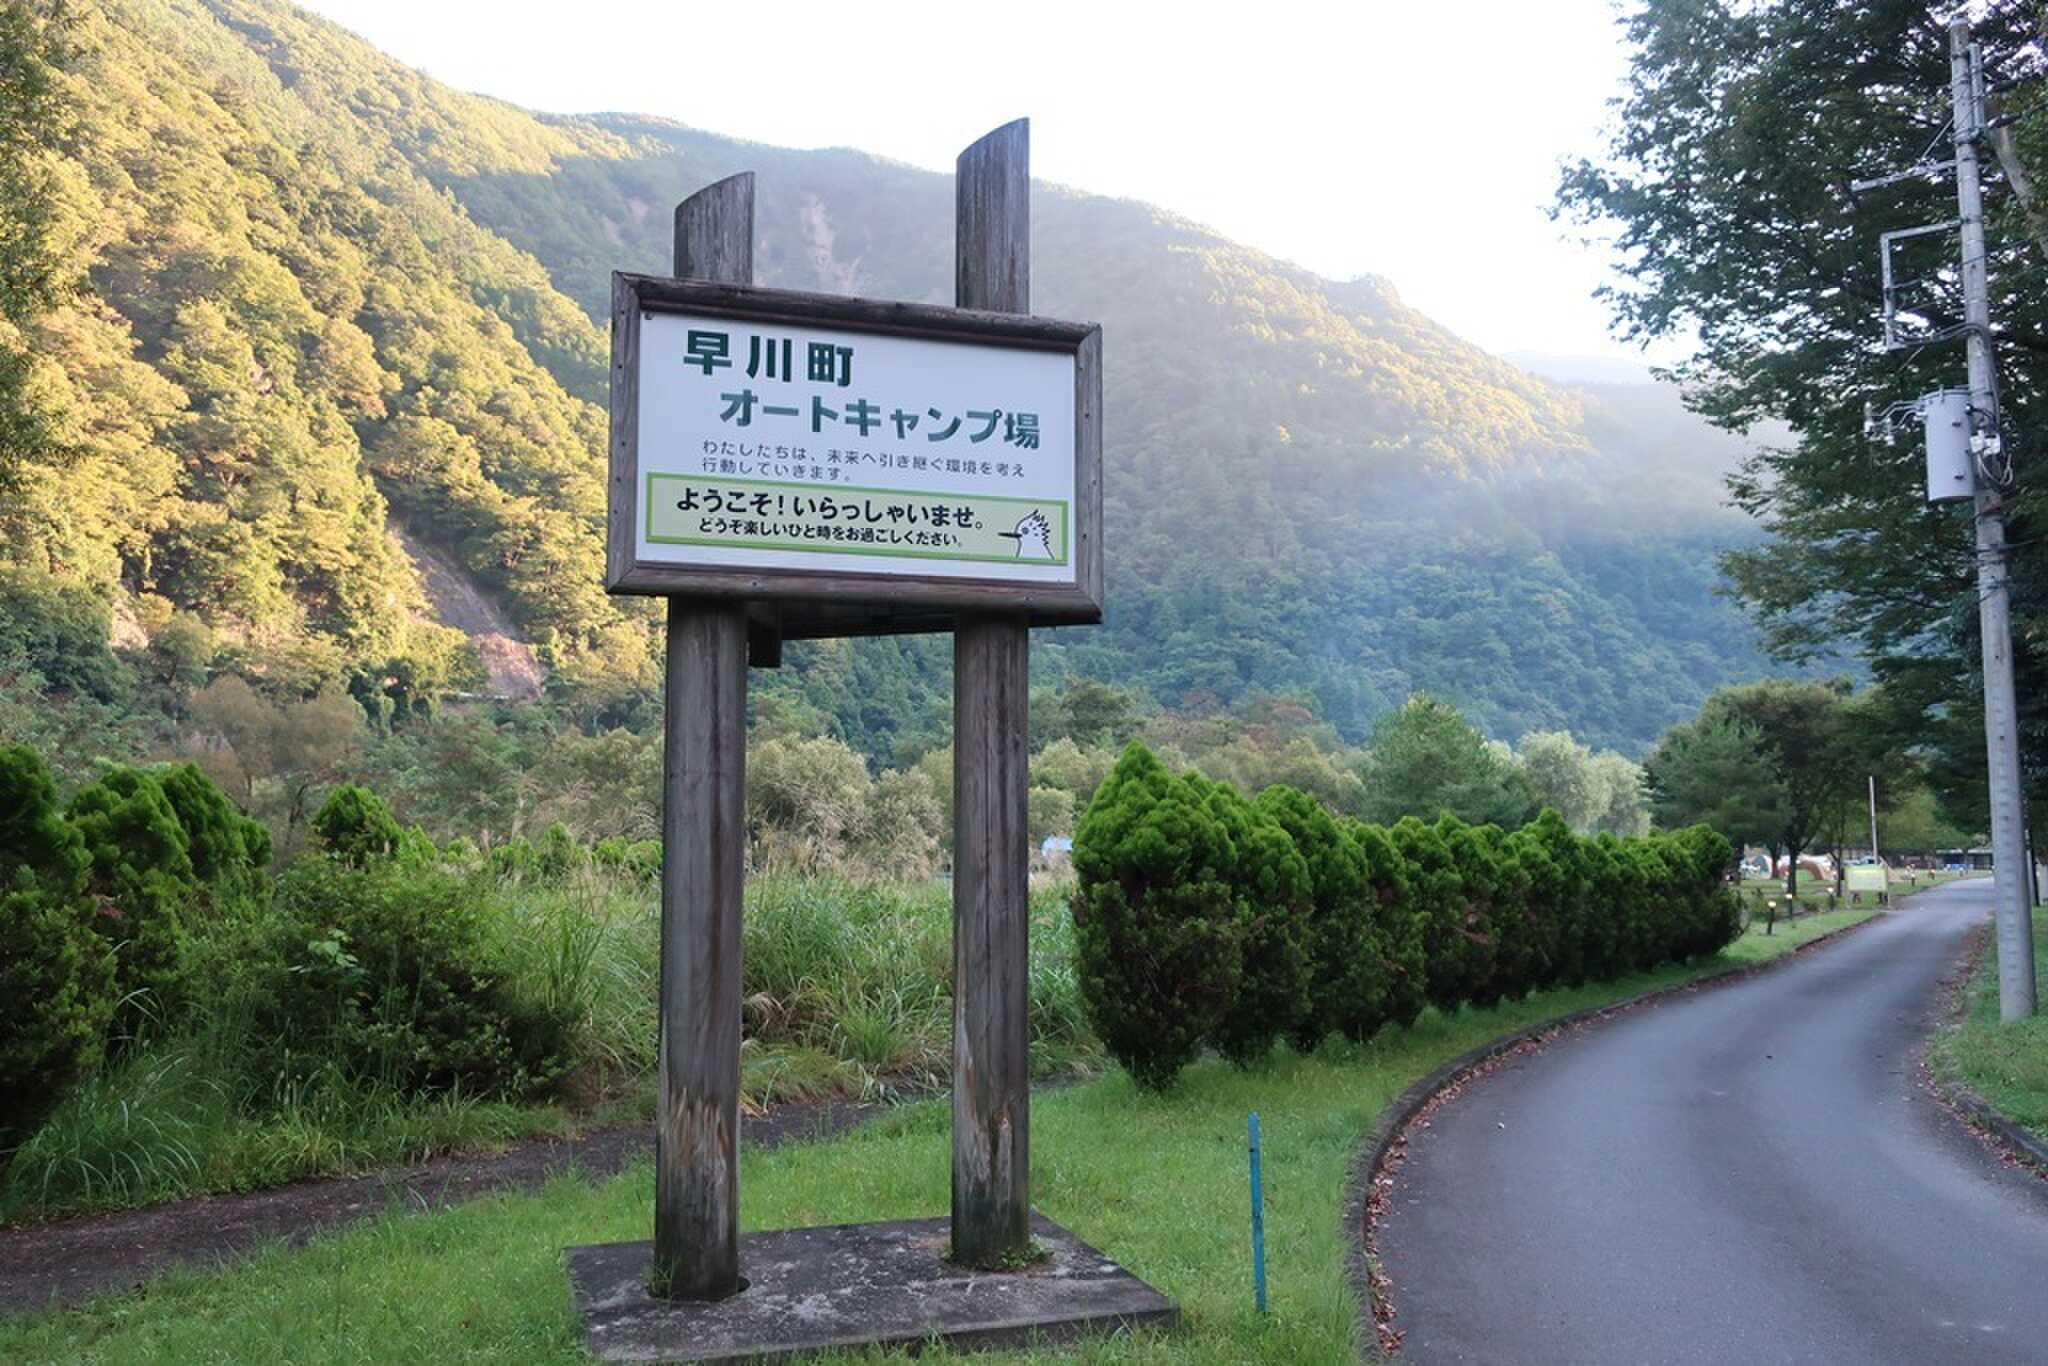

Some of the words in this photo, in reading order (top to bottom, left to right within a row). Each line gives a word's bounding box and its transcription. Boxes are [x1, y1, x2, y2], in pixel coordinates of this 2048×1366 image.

[683, 329, 853, 387] 早川町
[719, 389, 1041, 450] オートキャンプ場
[702, 439, 1025, 478] わたしたちは、未来へ引き継ぐ環境を考え
[702, 457, 851, 482] 行動していきます。
[699, 517, 962, 548] どうぞ楽しいひと時をお過ごしください。
